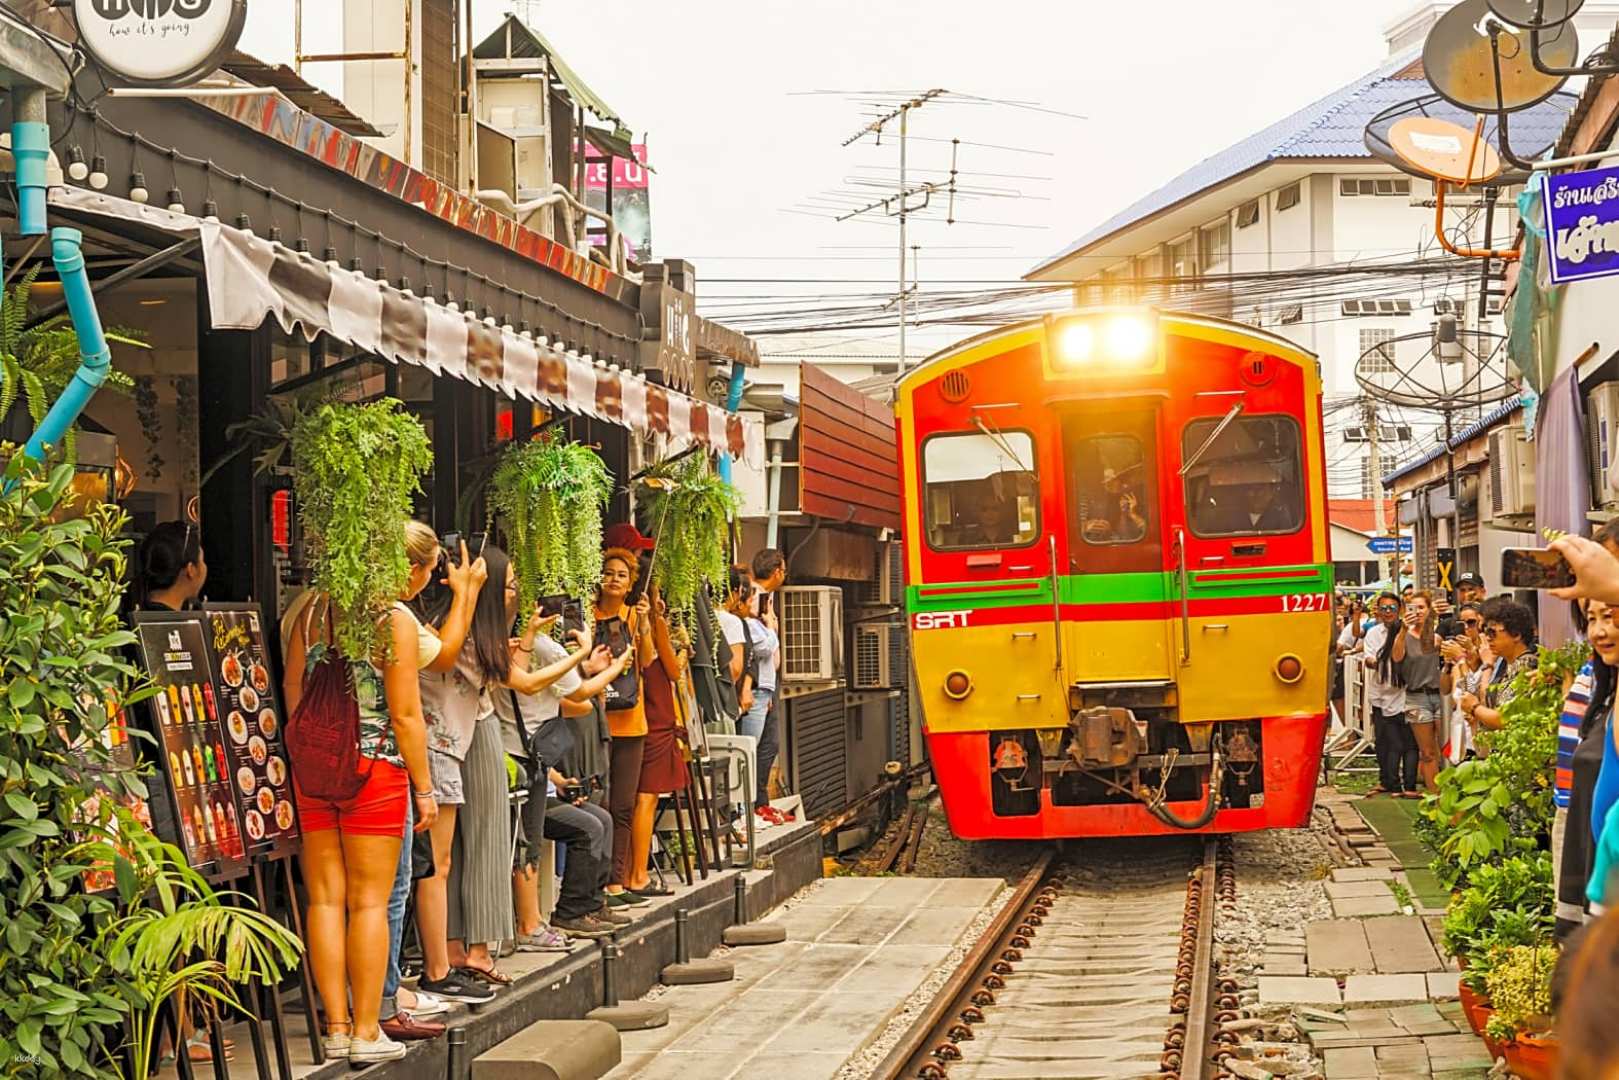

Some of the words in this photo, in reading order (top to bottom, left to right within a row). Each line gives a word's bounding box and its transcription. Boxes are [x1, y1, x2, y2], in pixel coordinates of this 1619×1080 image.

[109, 23, 131, 37] how
[136, 21, 155, 36] it's
[161, 22, 190, 39] going
[1554, 177, 1619, 209] ร้านเสริ
[1280, 593, 1326, 612] 1227
[915, 609, 973, 630] SRT
